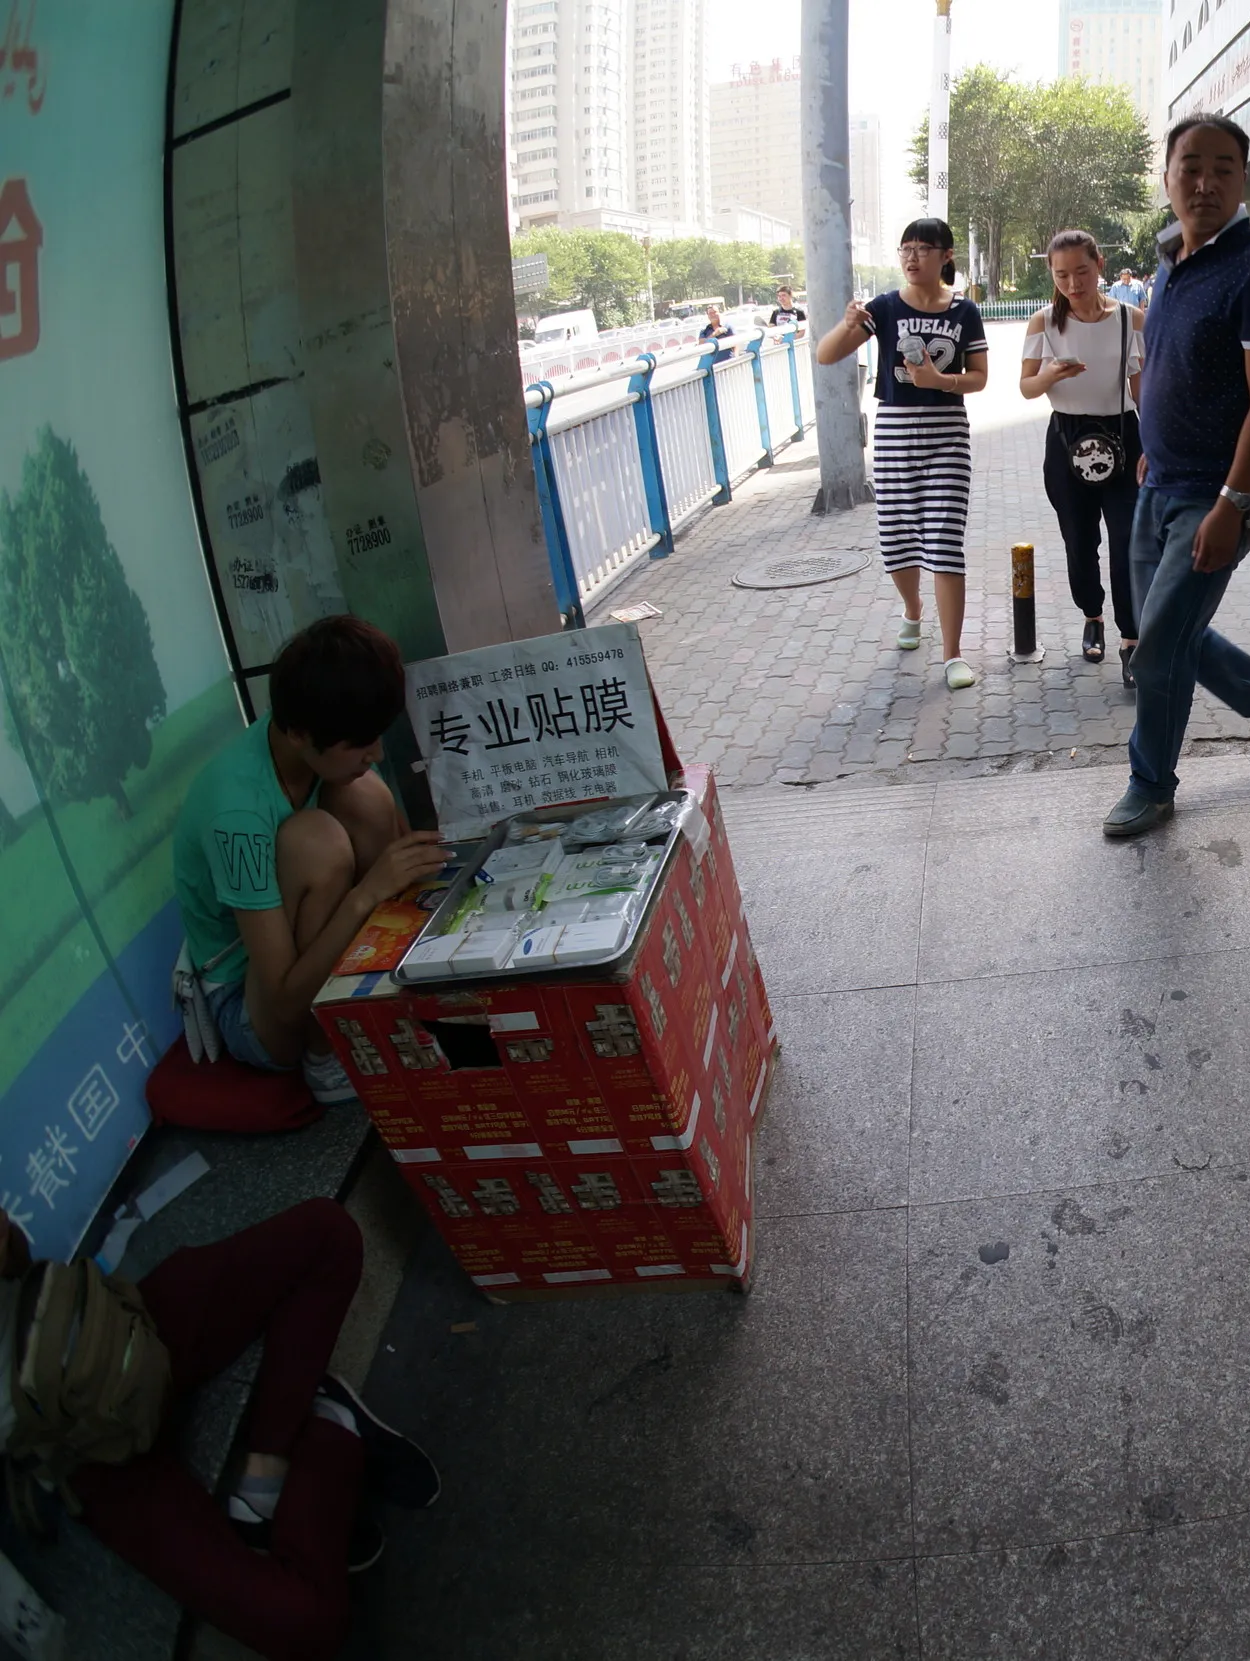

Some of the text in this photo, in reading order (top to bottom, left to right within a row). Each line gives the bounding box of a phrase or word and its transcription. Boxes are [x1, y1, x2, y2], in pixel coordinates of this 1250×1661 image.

[347, 527, 392, 556] 7728900
[415, 674, 484, 700] 招聘网络兼职
[489, 663, 537, 683] 工资日结
[566, 648, 624, 668] 415559478
[429, 677, 635, 756] 专业贴膜
[461, 746, 620, 784] 手机 平板电脑 汽车导航 相机
[528, 771, 552, 789] 钻石
[557, 763, 618, 783] 钢化玻璃膜
[513, 791, 537, 809] 耳机
[541, 787, 578, 804] 数据线
[582, 780, 618, 798] 充电器
